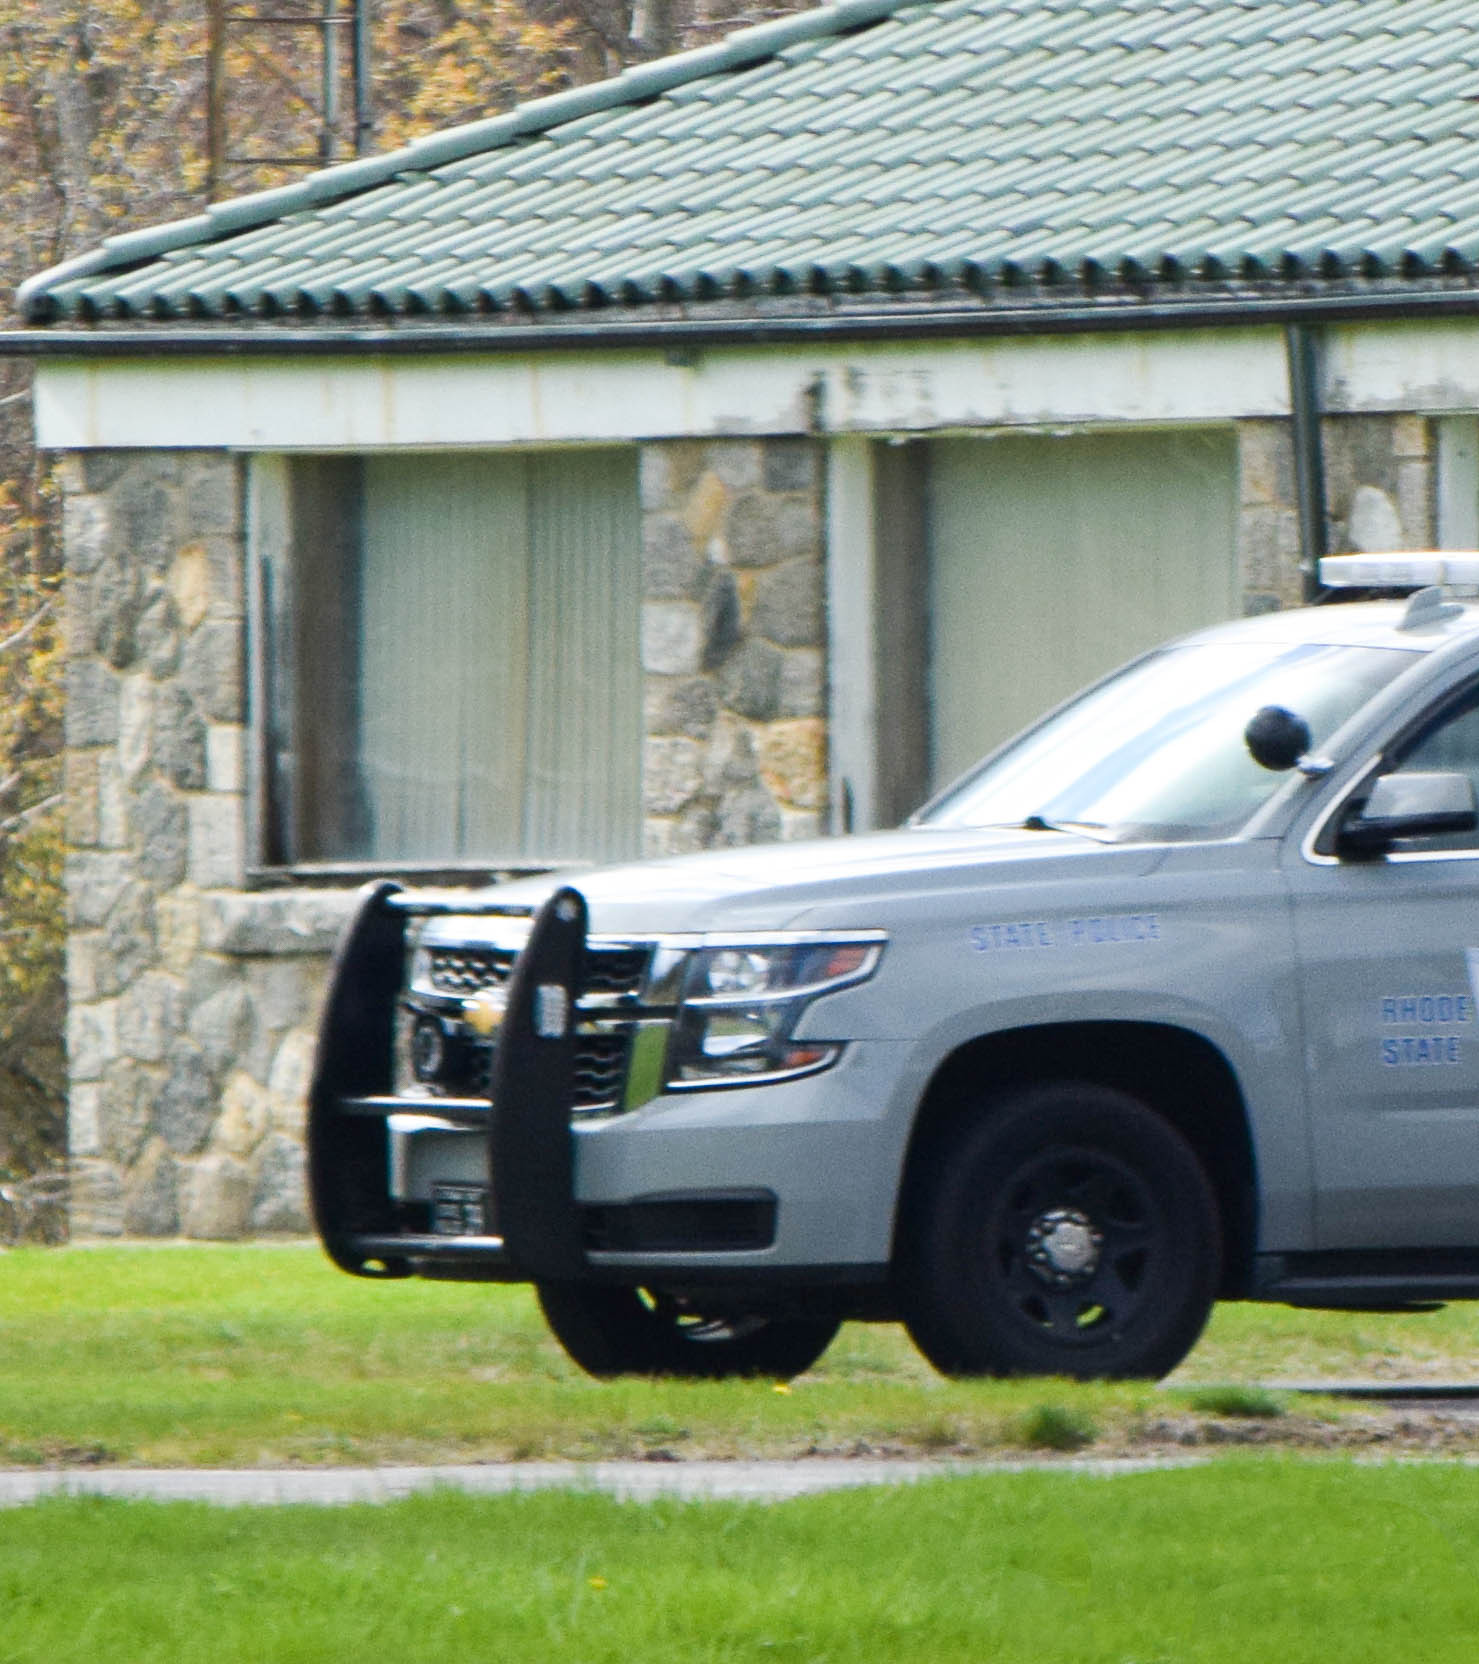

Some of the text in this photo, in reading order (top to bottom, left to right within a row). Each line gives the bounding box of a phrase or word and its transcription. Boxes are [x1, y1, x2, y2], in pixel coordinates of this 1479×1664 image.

[971, 915, 1159, 951] STATE POLICE
[1382, 995, 1470, 1024] RHODE
[1382, 1035, 1460, 1065] STATE
